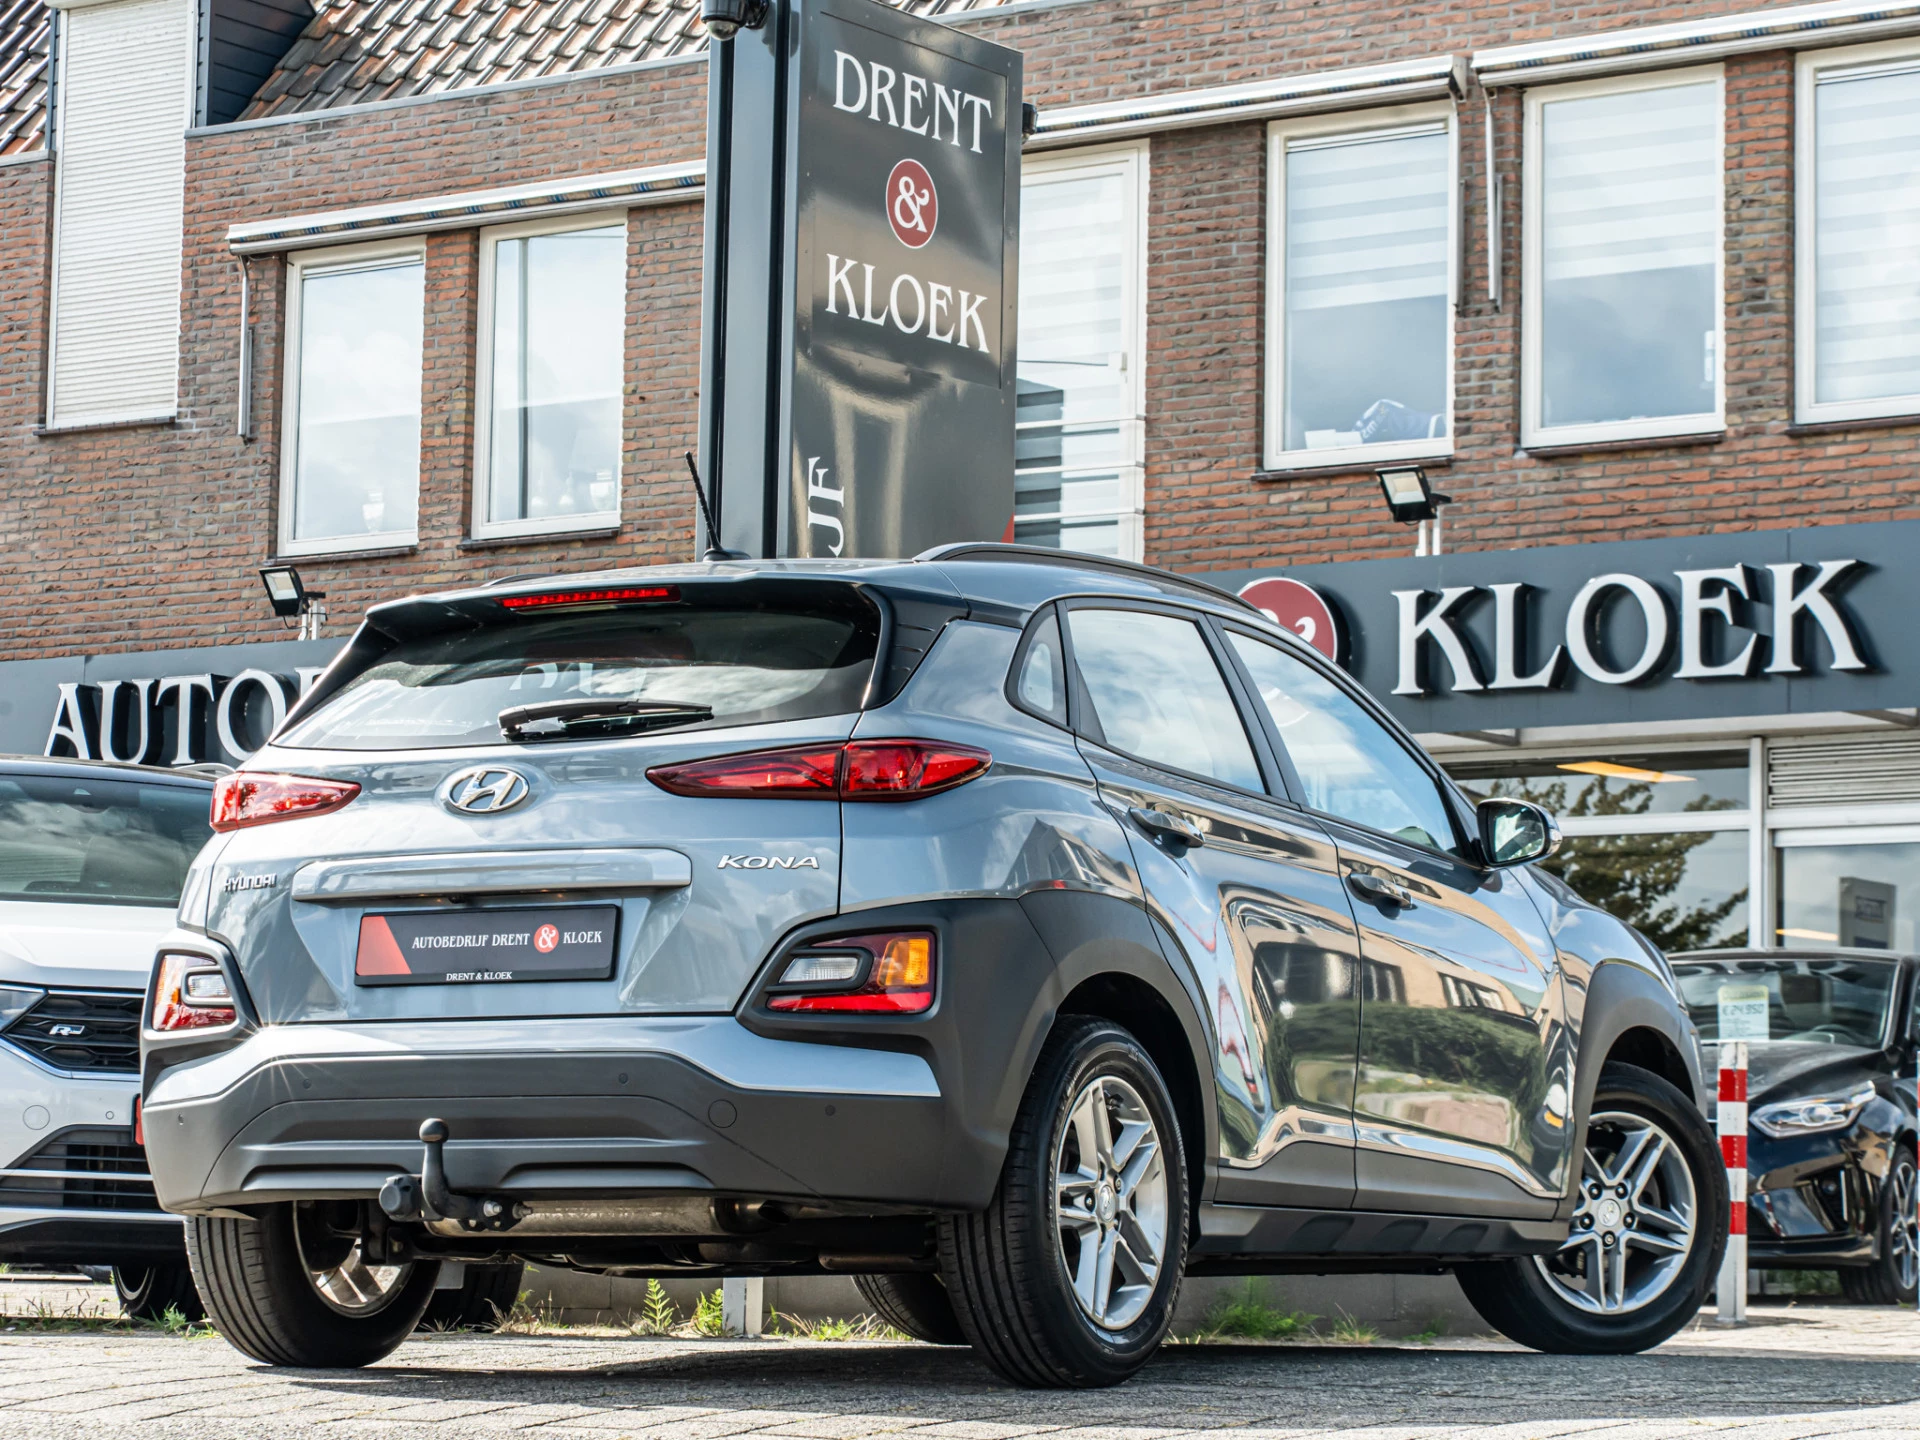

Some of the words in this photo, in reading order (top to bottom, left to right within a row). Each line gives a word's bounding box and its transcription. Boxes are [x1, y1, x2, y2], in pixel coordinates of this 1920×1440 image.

[833, 50, 992, 154] DRENT
[894, 176, 930, 233] &
[825, 253, 991, 354] KLOEK
[807, 456, 844, 558] JF
[1391, 559, 1868, 695] KLOEK
[44, 667, 331, 765] AUTO
[224, 873, 277, 892] HYUNDAI
[717, 855, 819, 869] KONA
[411, 934, 489, 949] AUTOBEDRIJF
[491, 933, 530, 947] DRENT
[538, 926, 556, 949] &
[562, 930, 602, 944] KLOEK
[446, 972, 475, 981] DRENT
[483, 971, 512, 980] KLOEK
